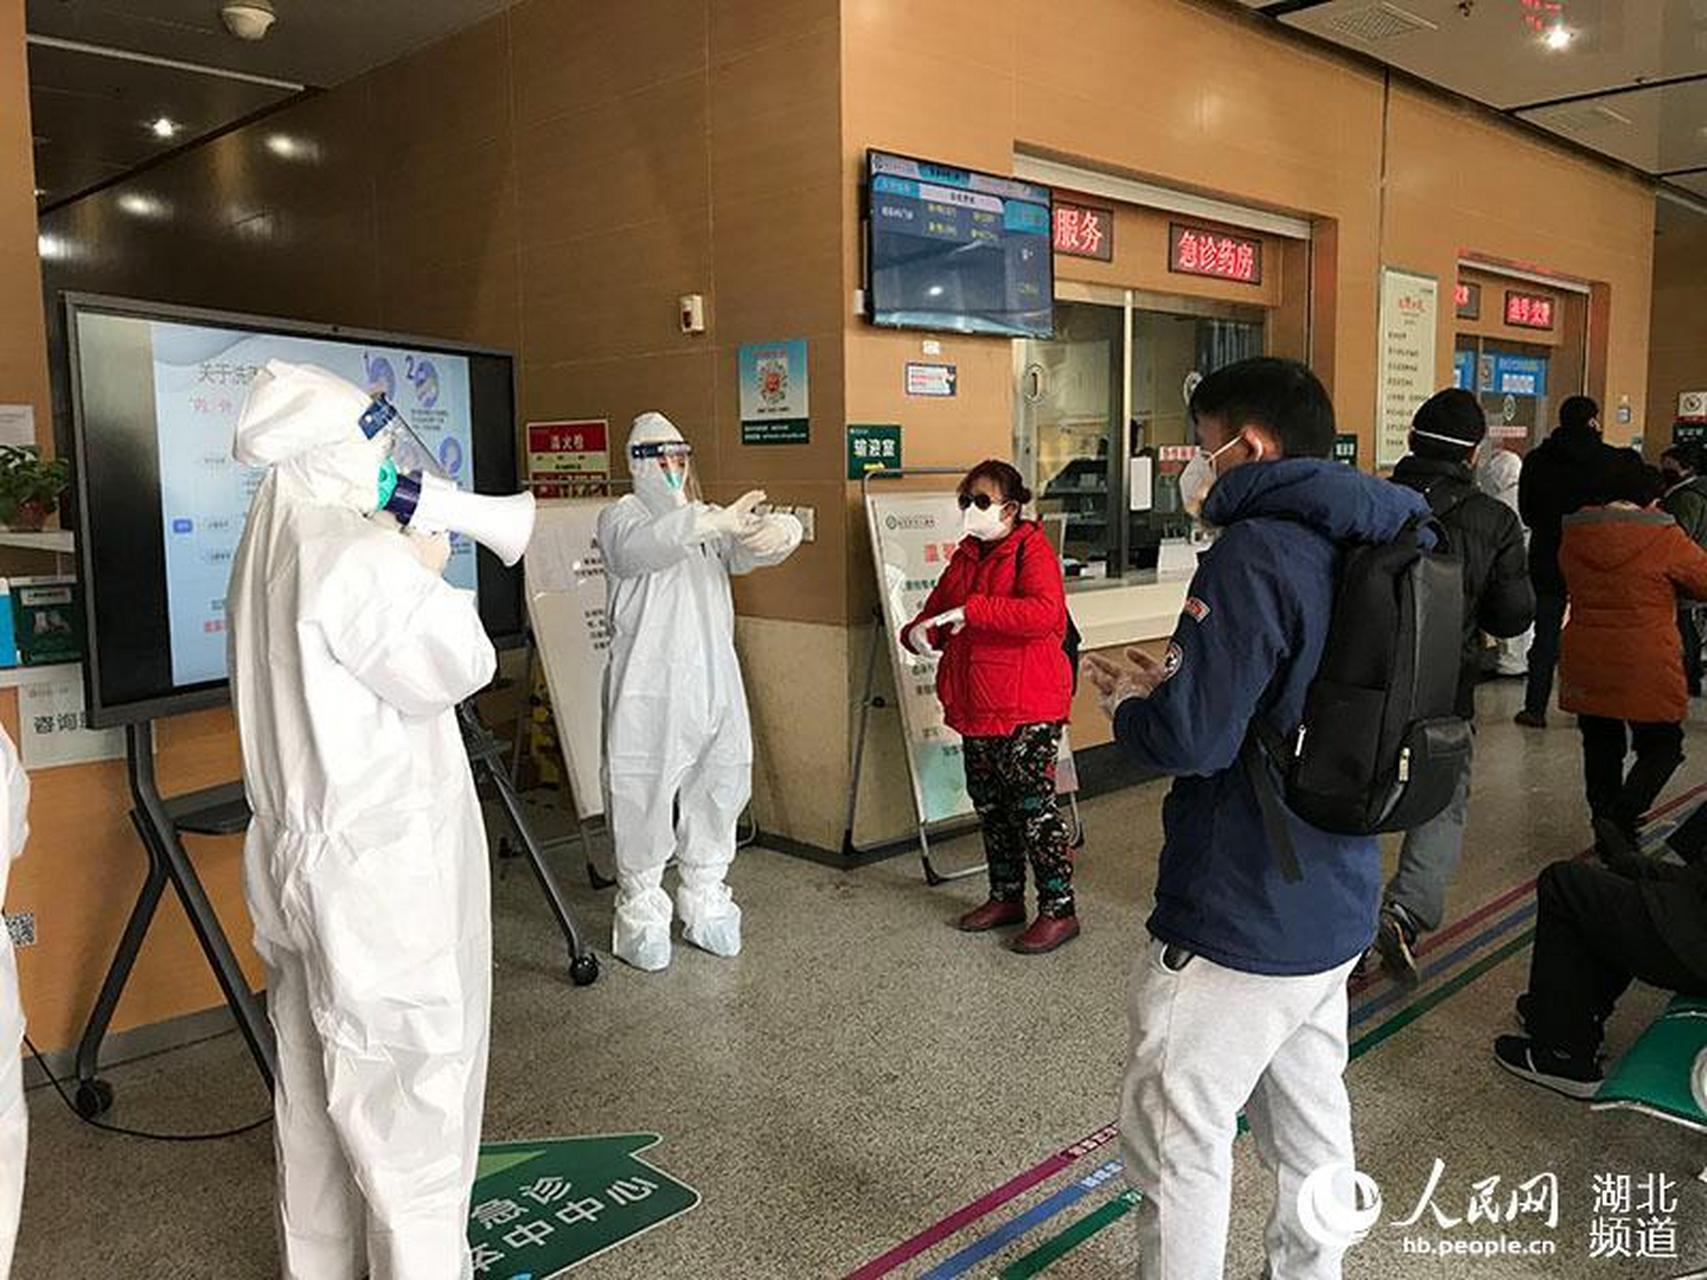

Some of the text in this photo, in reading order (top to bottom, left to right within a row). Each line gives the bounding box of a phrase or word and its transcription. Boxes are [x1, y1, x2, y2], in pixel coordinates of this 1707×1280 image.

[1054, 208, 1102, 252] 服务
[1178, 230, 1254, 278] 急诊药房
[34, 711, 87, 734] 咨询
[471, 1176, 572, 1230] 急诊
